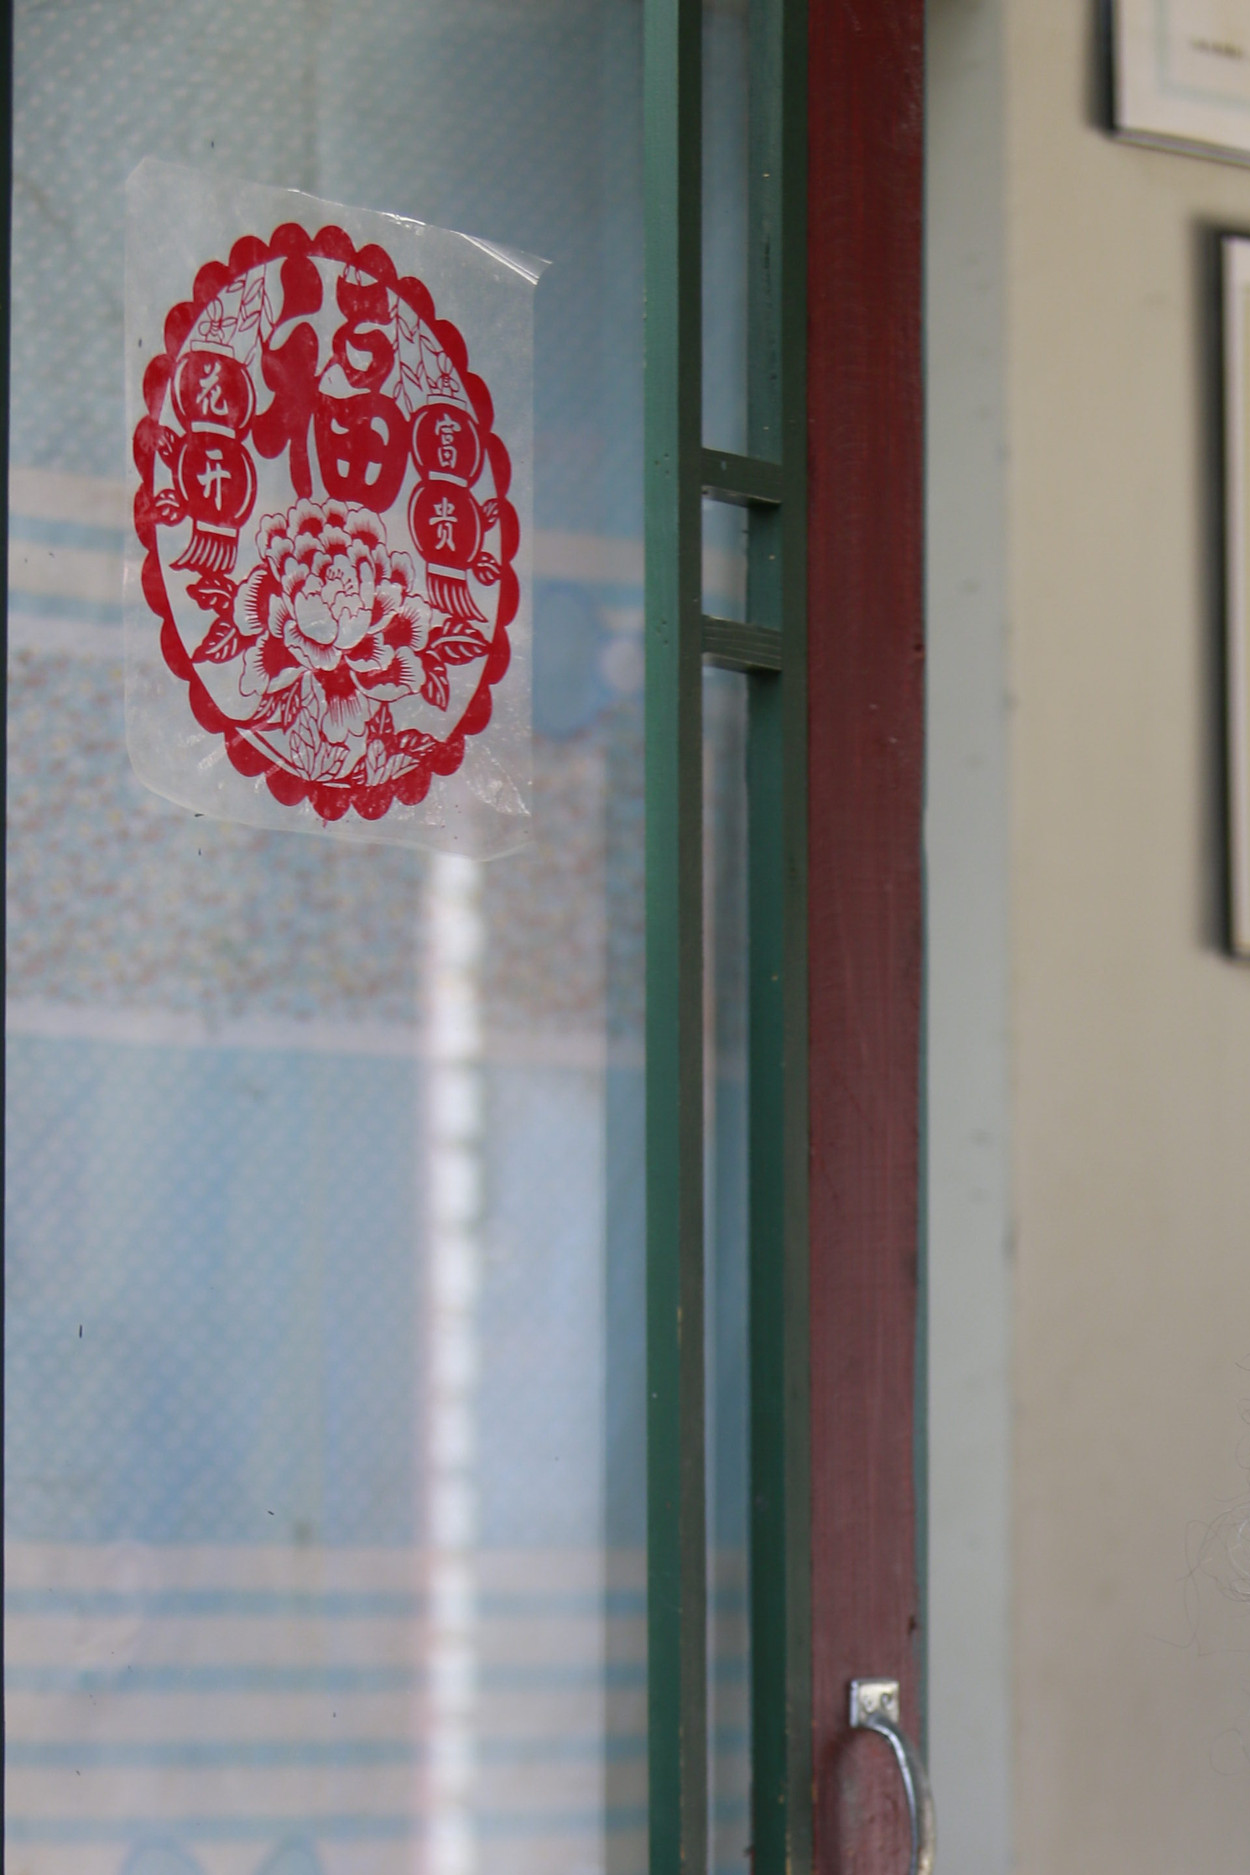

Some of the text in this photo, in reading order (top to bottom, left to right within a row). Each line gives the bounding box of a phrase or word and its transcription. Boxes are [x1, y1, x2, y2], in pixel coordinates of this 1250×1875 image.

[194, 361, 234, 511] 花开
[252, 252, 410, 515] 福
[428, 414, 464, 555] 富贵
